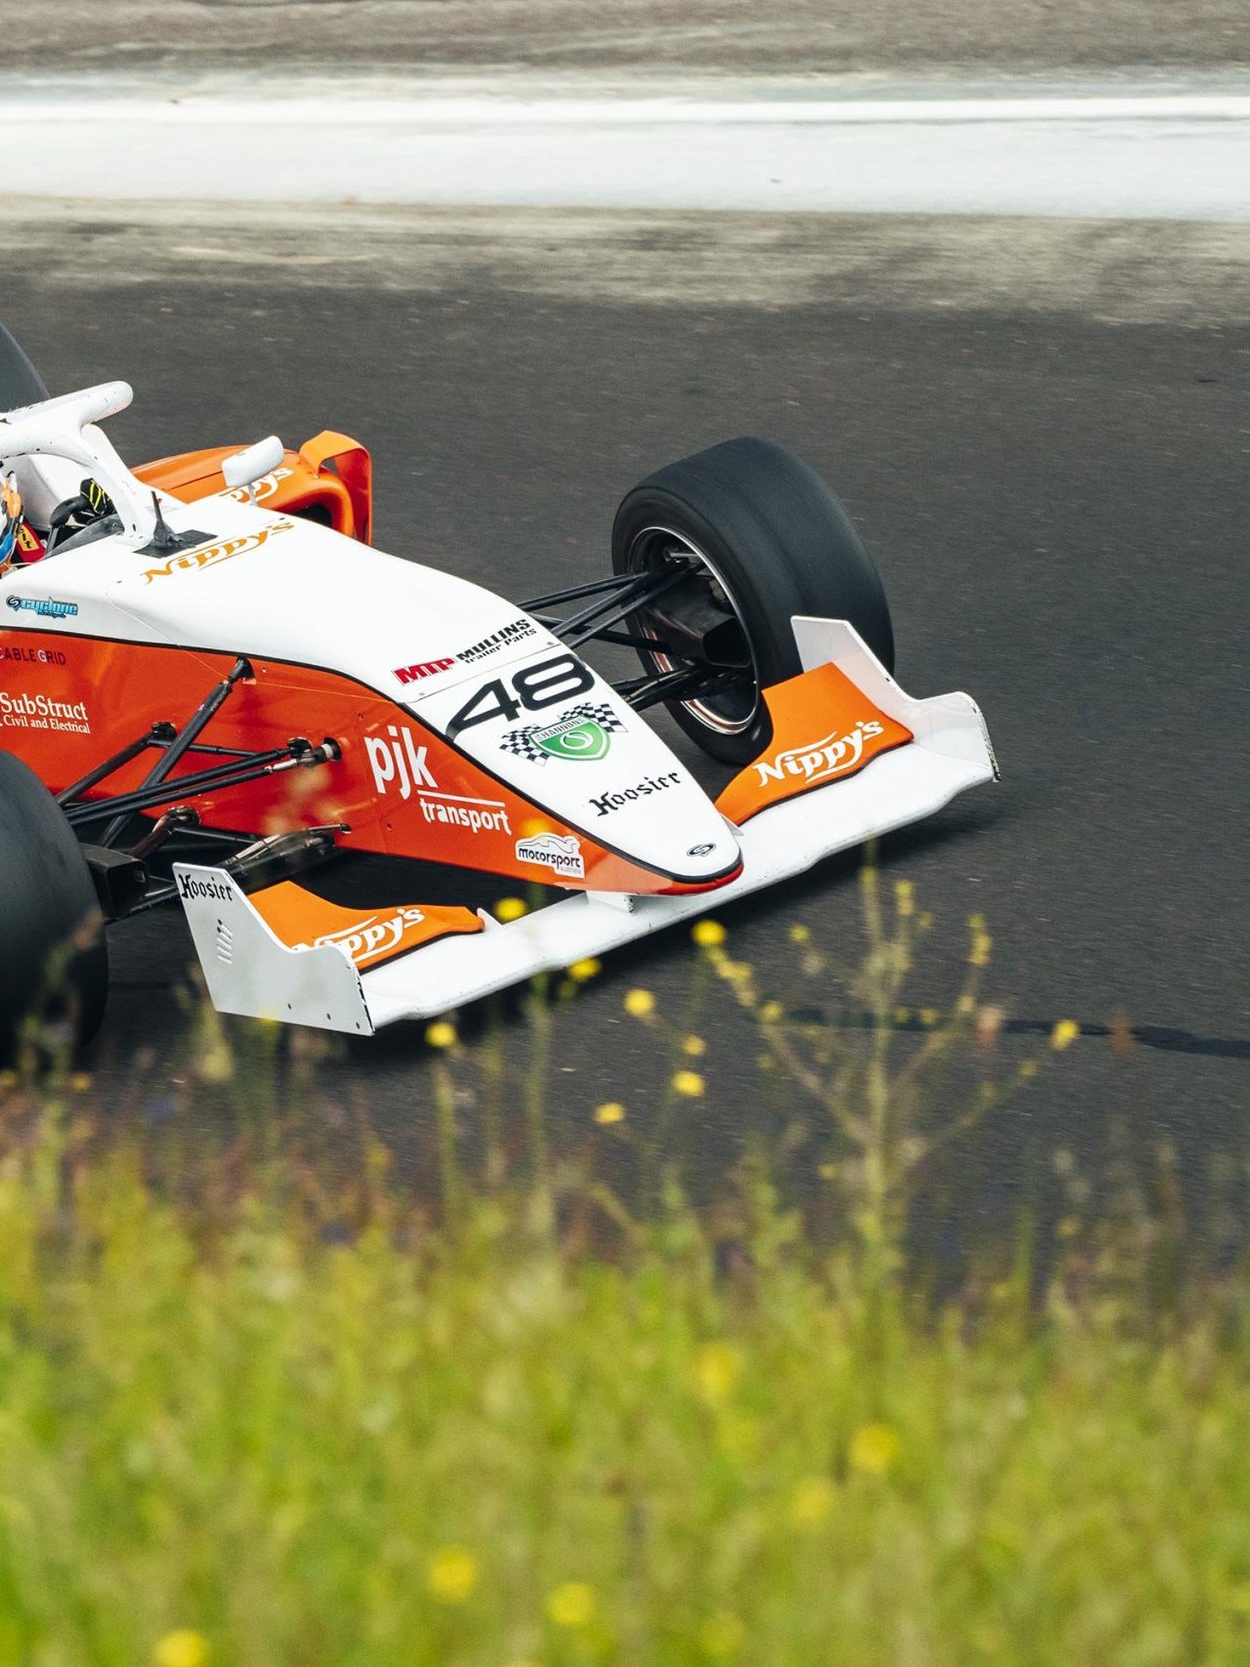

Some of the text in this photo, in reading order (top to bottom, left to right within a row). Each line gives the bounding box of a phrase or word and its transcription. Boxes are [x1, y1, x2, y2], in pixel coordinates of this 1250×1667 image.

[140, 521, 295, 586] Nippy's
[455, 618, 532, 661] MULLINS
[392, 657, 456, 686] MTP
[445, 653, 596, 742] 48
[3, 714, 91, 734] Civil and Electrical
[534, 716, 586, 742] SHANNONS
[364, 725, 439, 800] pjk
[751, 720, 885, 788] Nippy's
[588, 770, 682, 818] Hoosier
[419, 797, 513, 836] transport
[517, 846, 582, 870] motorsport
[177, 873, 233, 902] Hoosier
